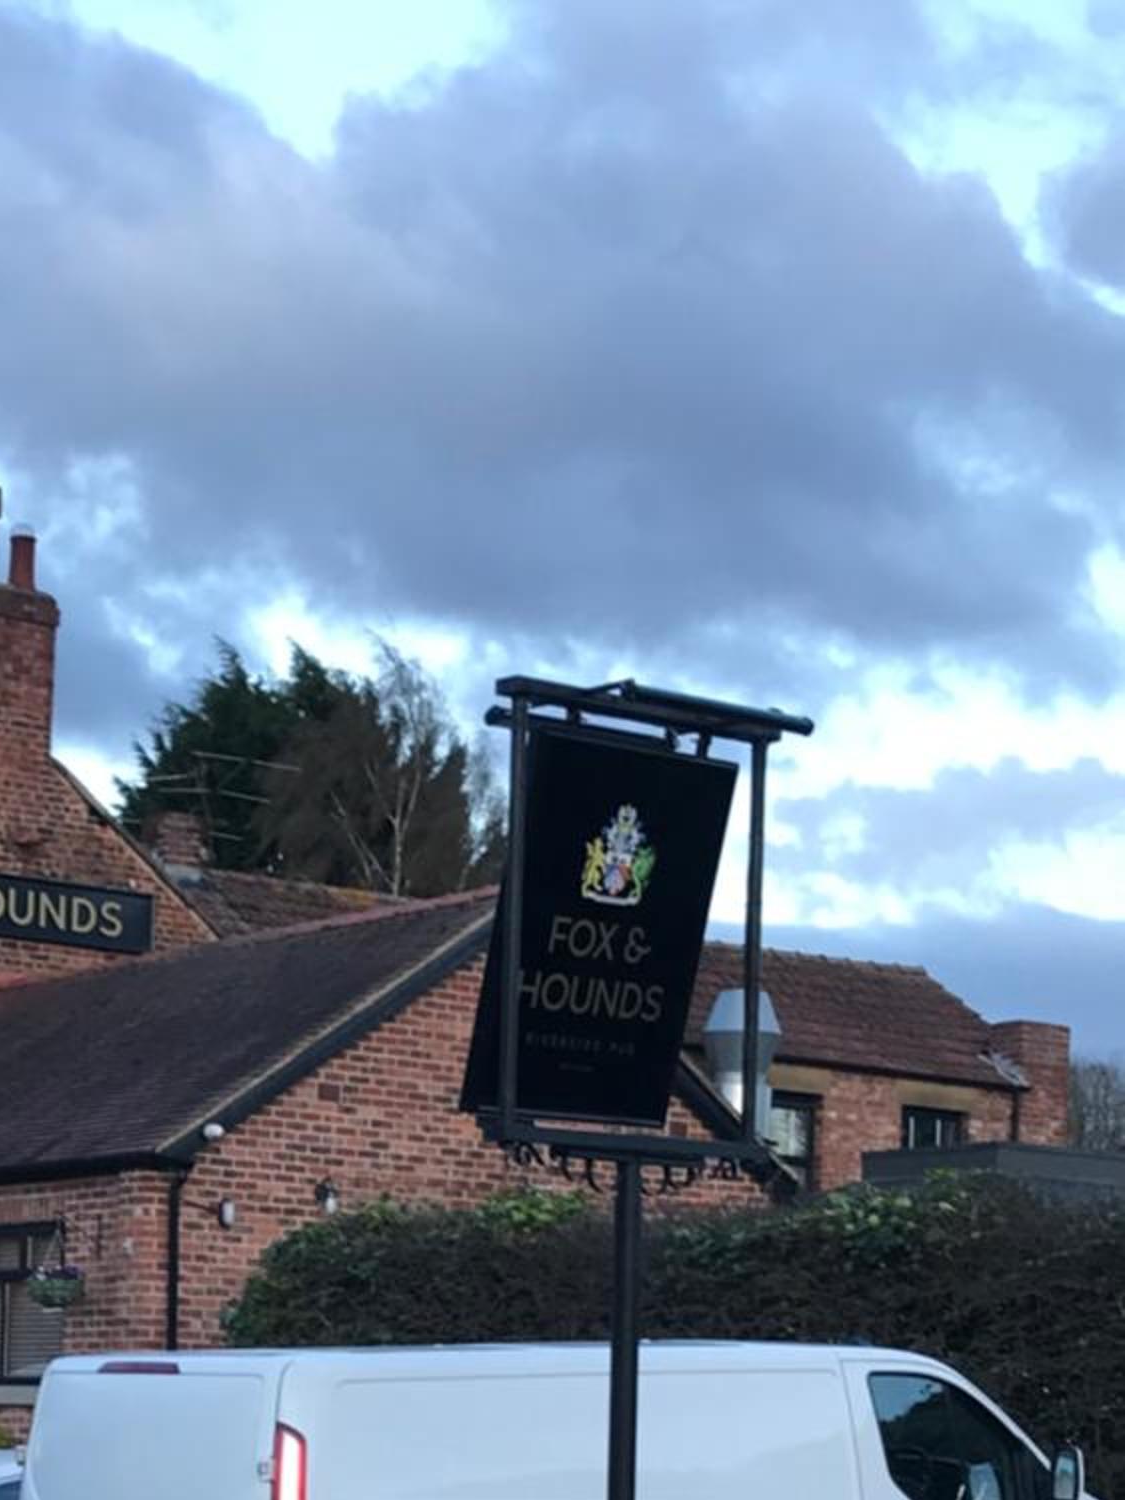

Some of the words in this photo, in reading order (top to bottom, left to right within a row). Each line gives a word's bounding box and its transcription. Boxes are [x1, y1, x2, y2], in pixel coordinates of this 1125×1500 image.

[548, 914, 619, 960] FOX
[623, 926, 651, 964] &
[515, 968, 665, 1022] HOUNDS
